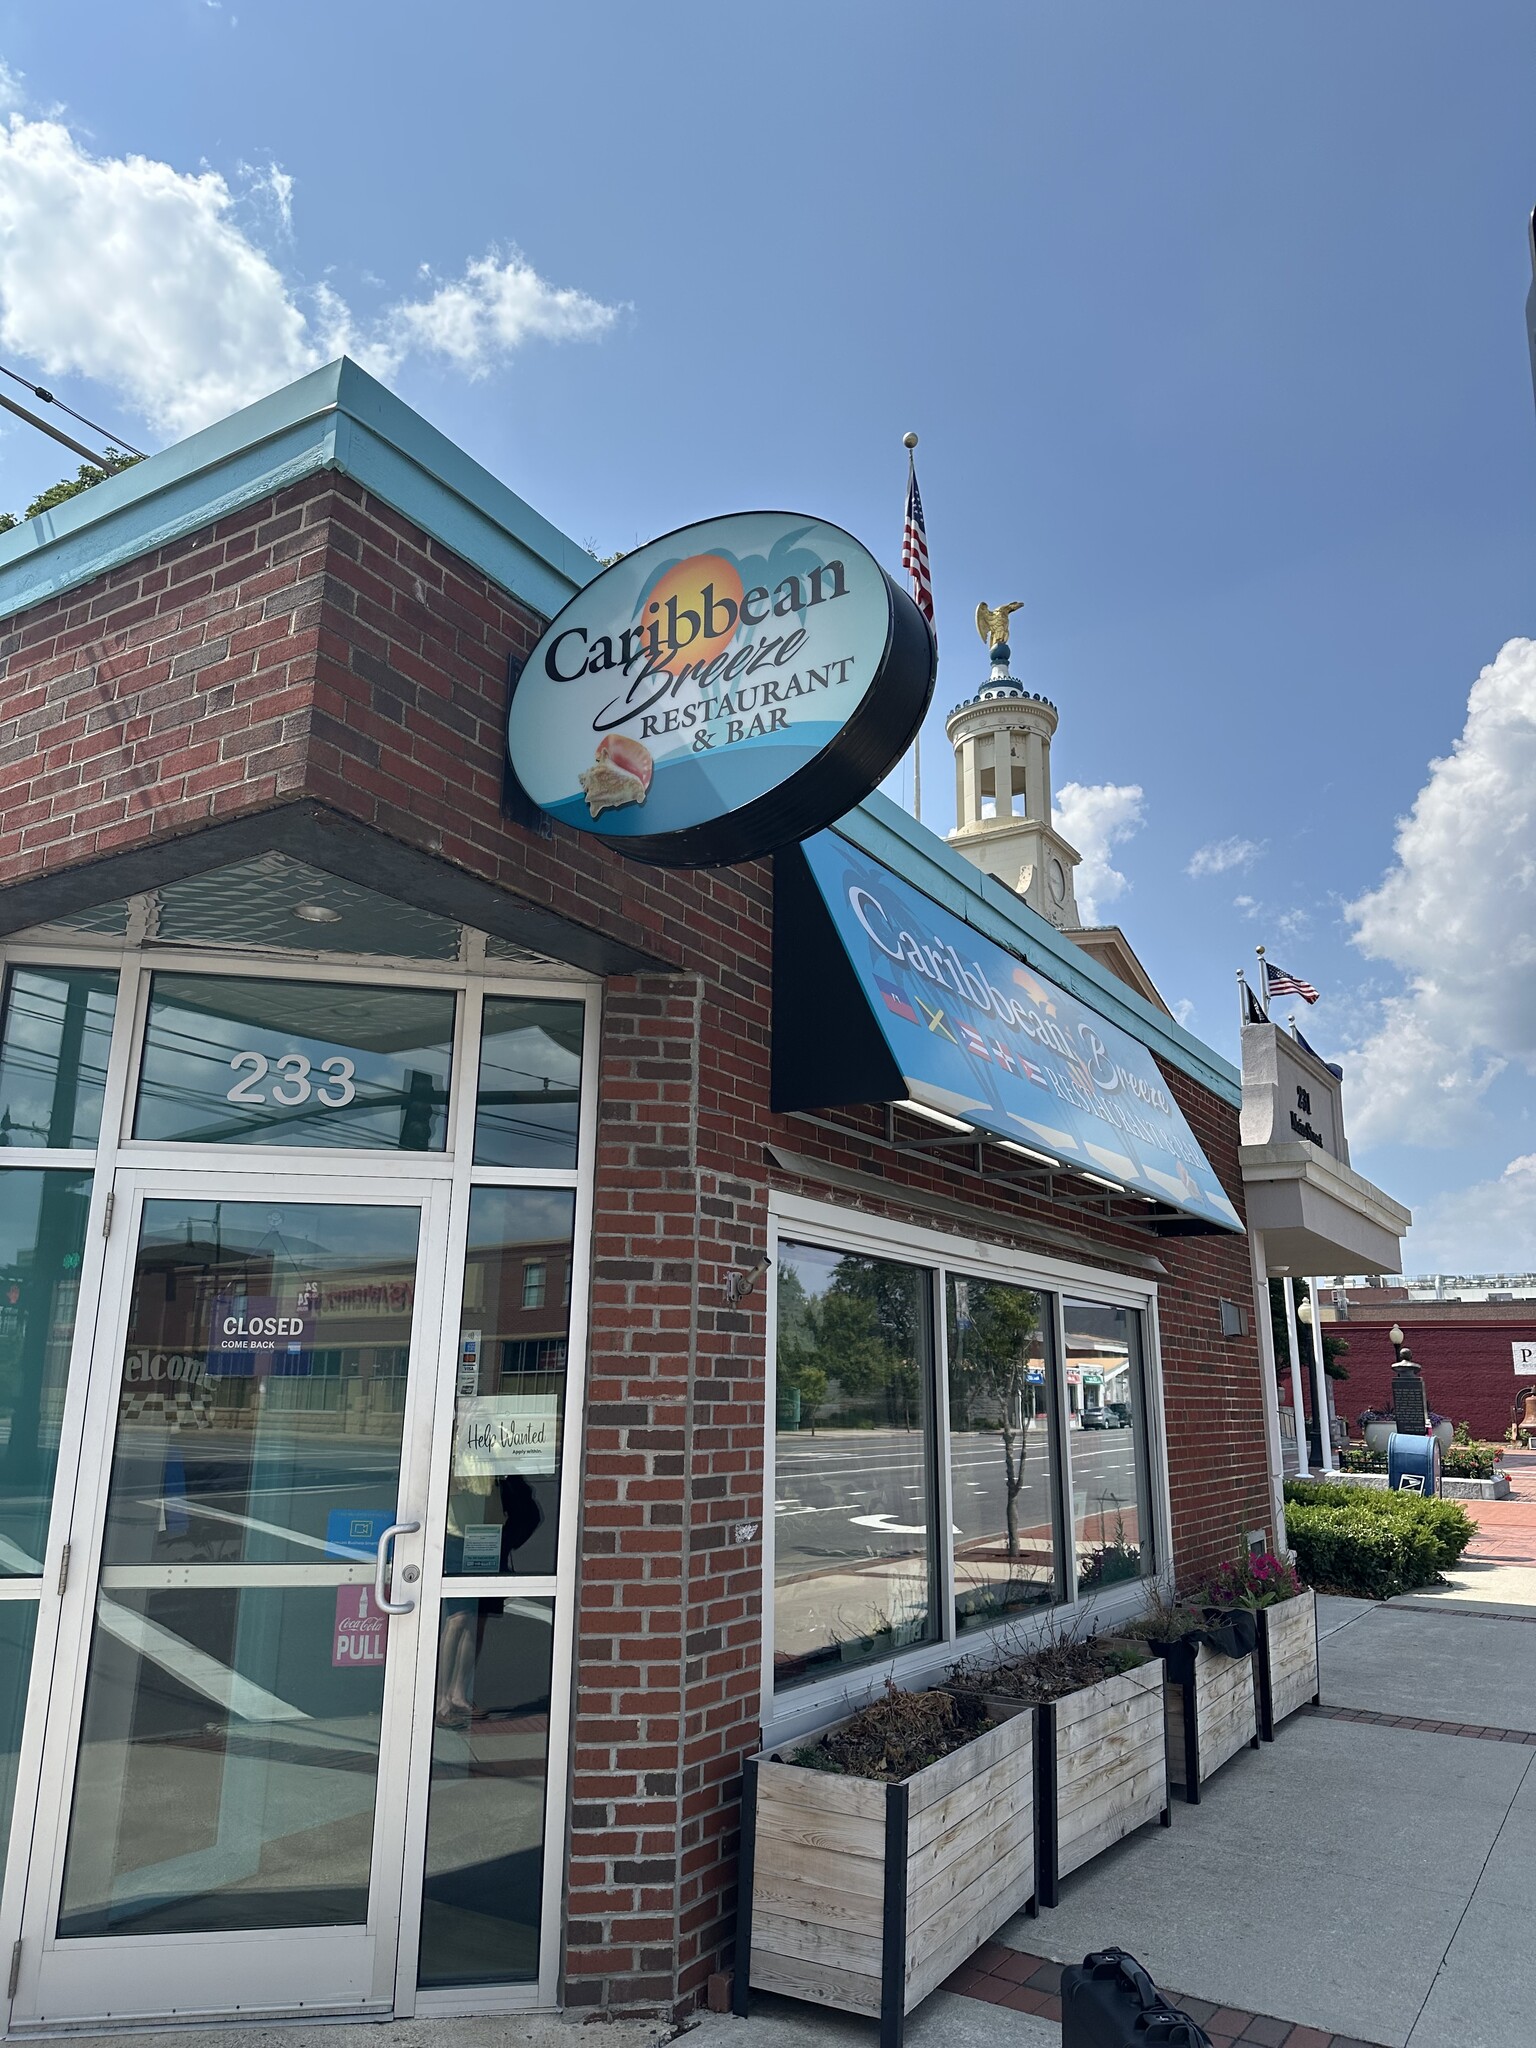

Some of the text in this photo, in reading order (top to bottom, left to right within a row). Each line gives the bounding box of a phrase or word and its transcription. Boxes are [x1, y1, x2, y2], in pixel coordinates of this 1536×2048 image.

[544, 559, 850, 683] Caribbean
[592, 628, 809, 731] Breeze
[639, 656, 855, 739] RESTAURANT
[692, 707, 792, 753] & BAR
[848, 885, 1169, 1114] Caribbean Breeze
[226, 1050, 357, 1108] 233
[1043, 1065, 1209, 1172] RESTAURANT & BAR
[221, 1340, 275, 1349] COME BACK
[223, 1316, 304, 1336] CLOSED
[125, 1350, 222, 1391] elcome
[1520, 1348, 1536, 1363] P
[468, 1420, 546, 1453] Help Wanted
[336, 1634, 385, 1661] PULL
